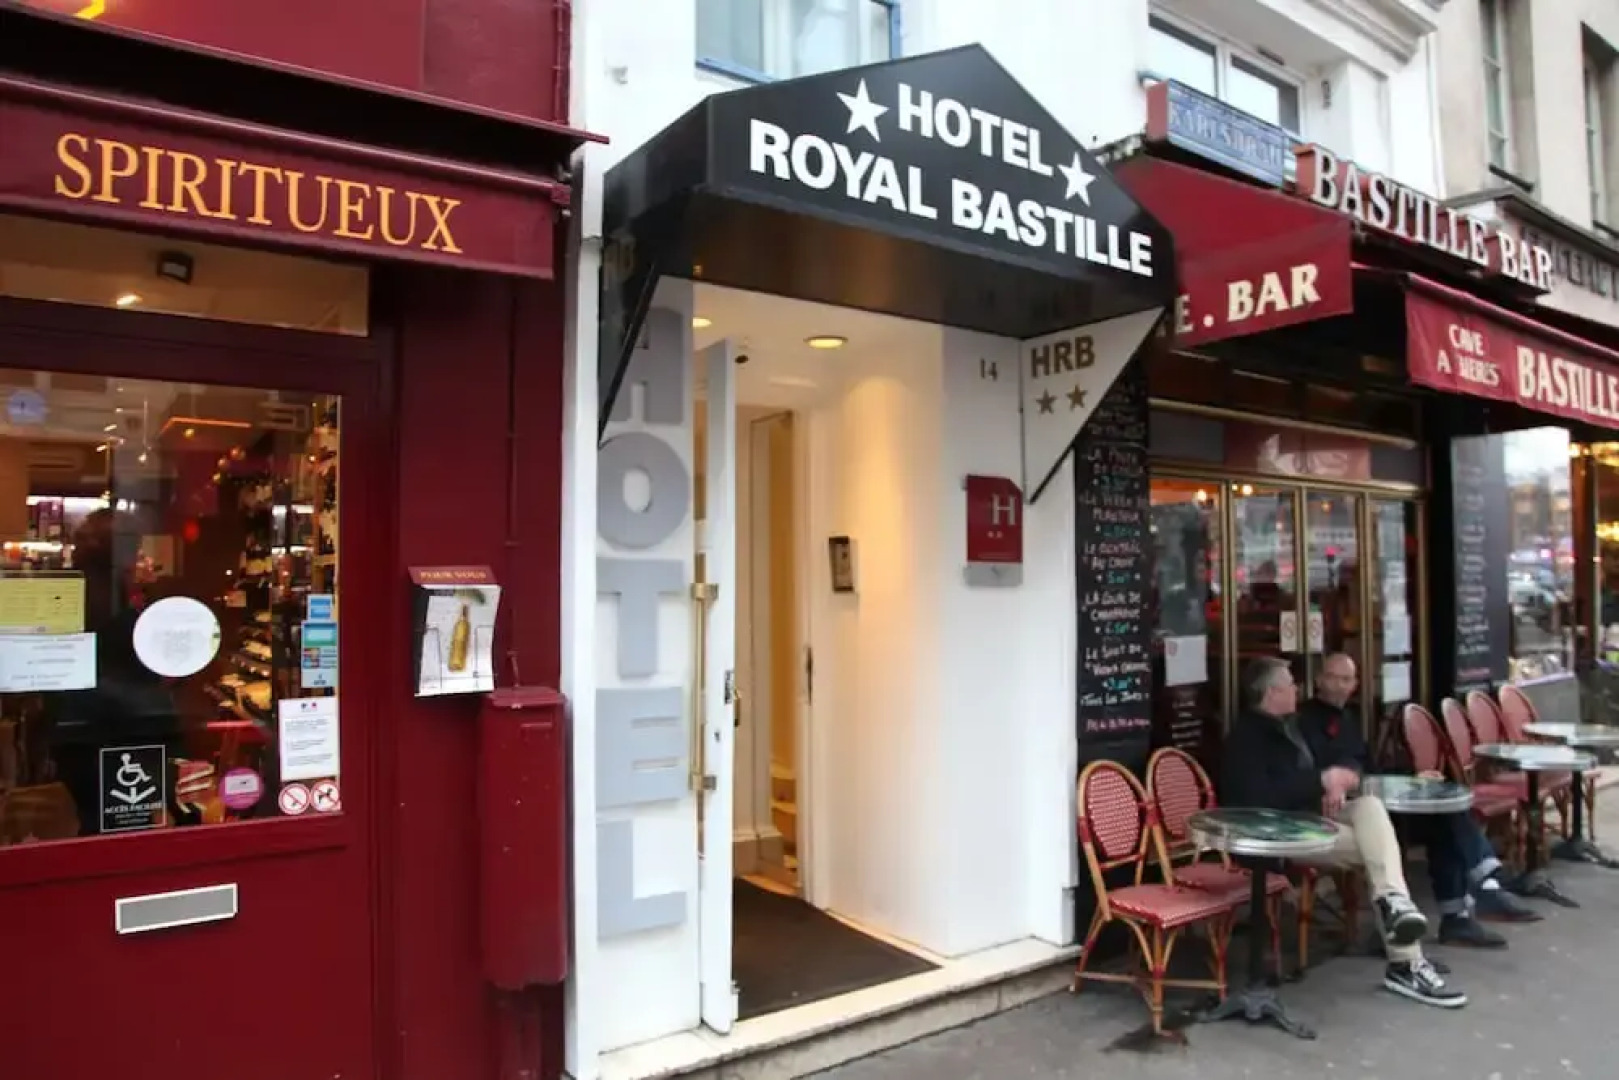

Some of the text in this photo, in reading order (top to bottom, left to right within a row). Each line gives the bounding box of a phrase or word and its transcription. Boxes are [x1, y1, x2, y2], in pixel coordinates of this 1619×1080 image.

[898, 83, 1054, 177] HOTEL
[54, 132, 463, 254] SPIRITUEUX
[749, 118, 1154, 277] ROYAL BASTILLE
[1310, 143, 1489, 269] BASTILLE
[1496, 230, 1554, 293] BAR
[1227, 263, 1322, 322] BAR
[980, 358, 998, 382] 14
[1030, 335, 1096, 378] HRB
[991, 493, 1016, 526] H
[596, 306, 690, 943] HOTEL
